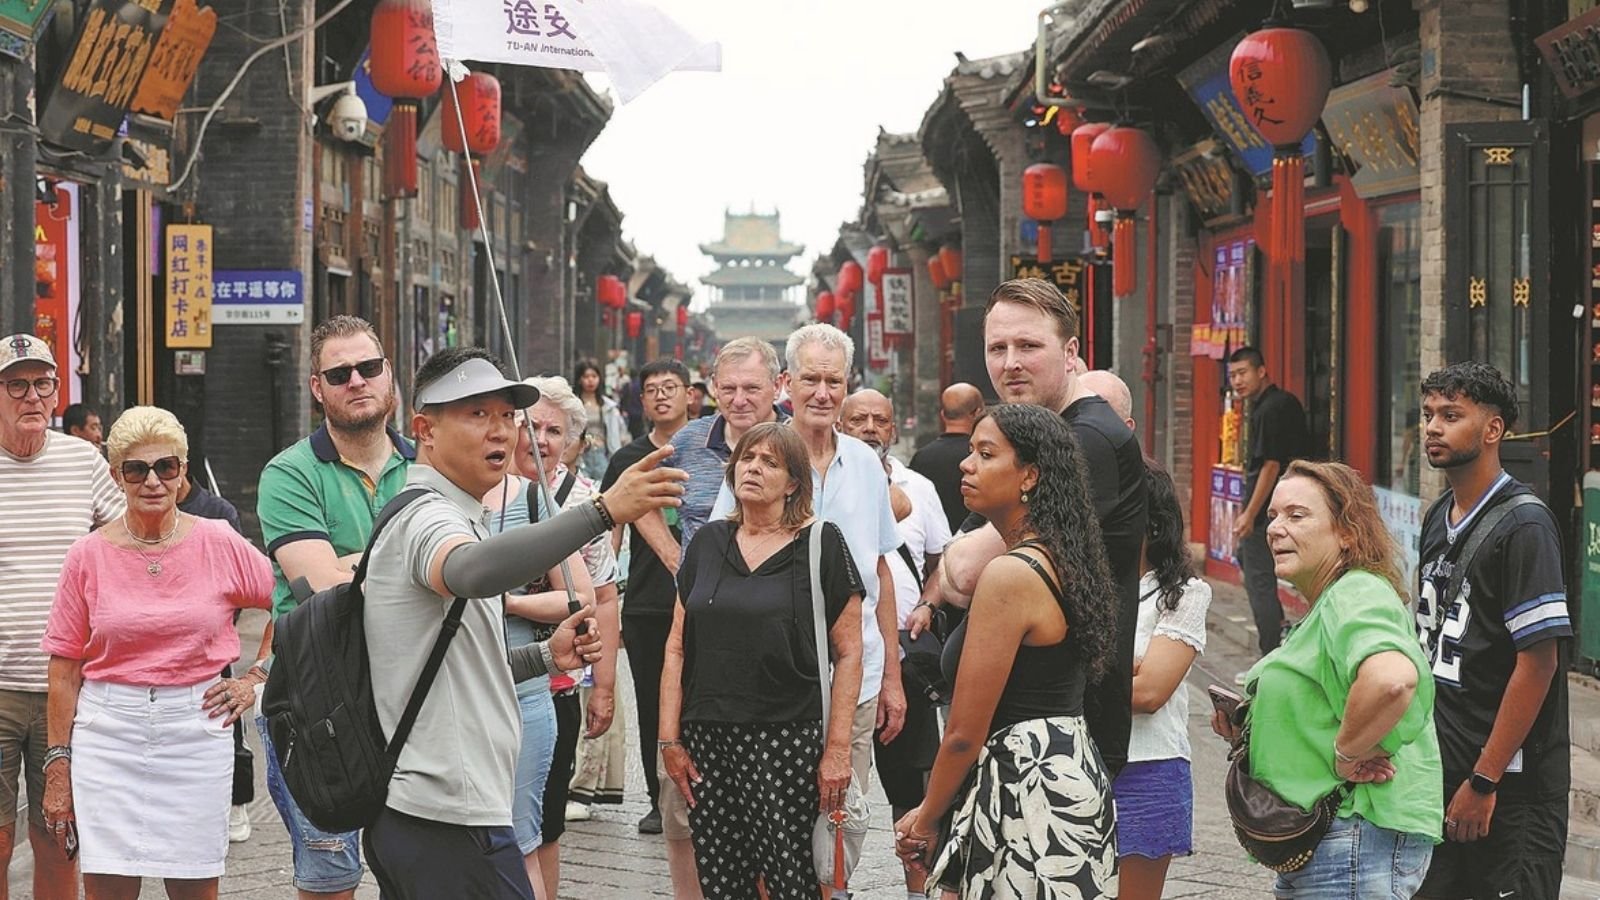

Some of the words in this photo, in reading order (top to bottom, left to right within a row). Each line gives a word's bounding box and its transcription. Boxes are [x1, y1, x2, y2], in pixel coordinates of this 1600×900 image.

[503, 0, 577, 40] 途安
[170, 235, 190, 337] 网红打卡店
[211, 281, 295, 299] 在平遥等你
